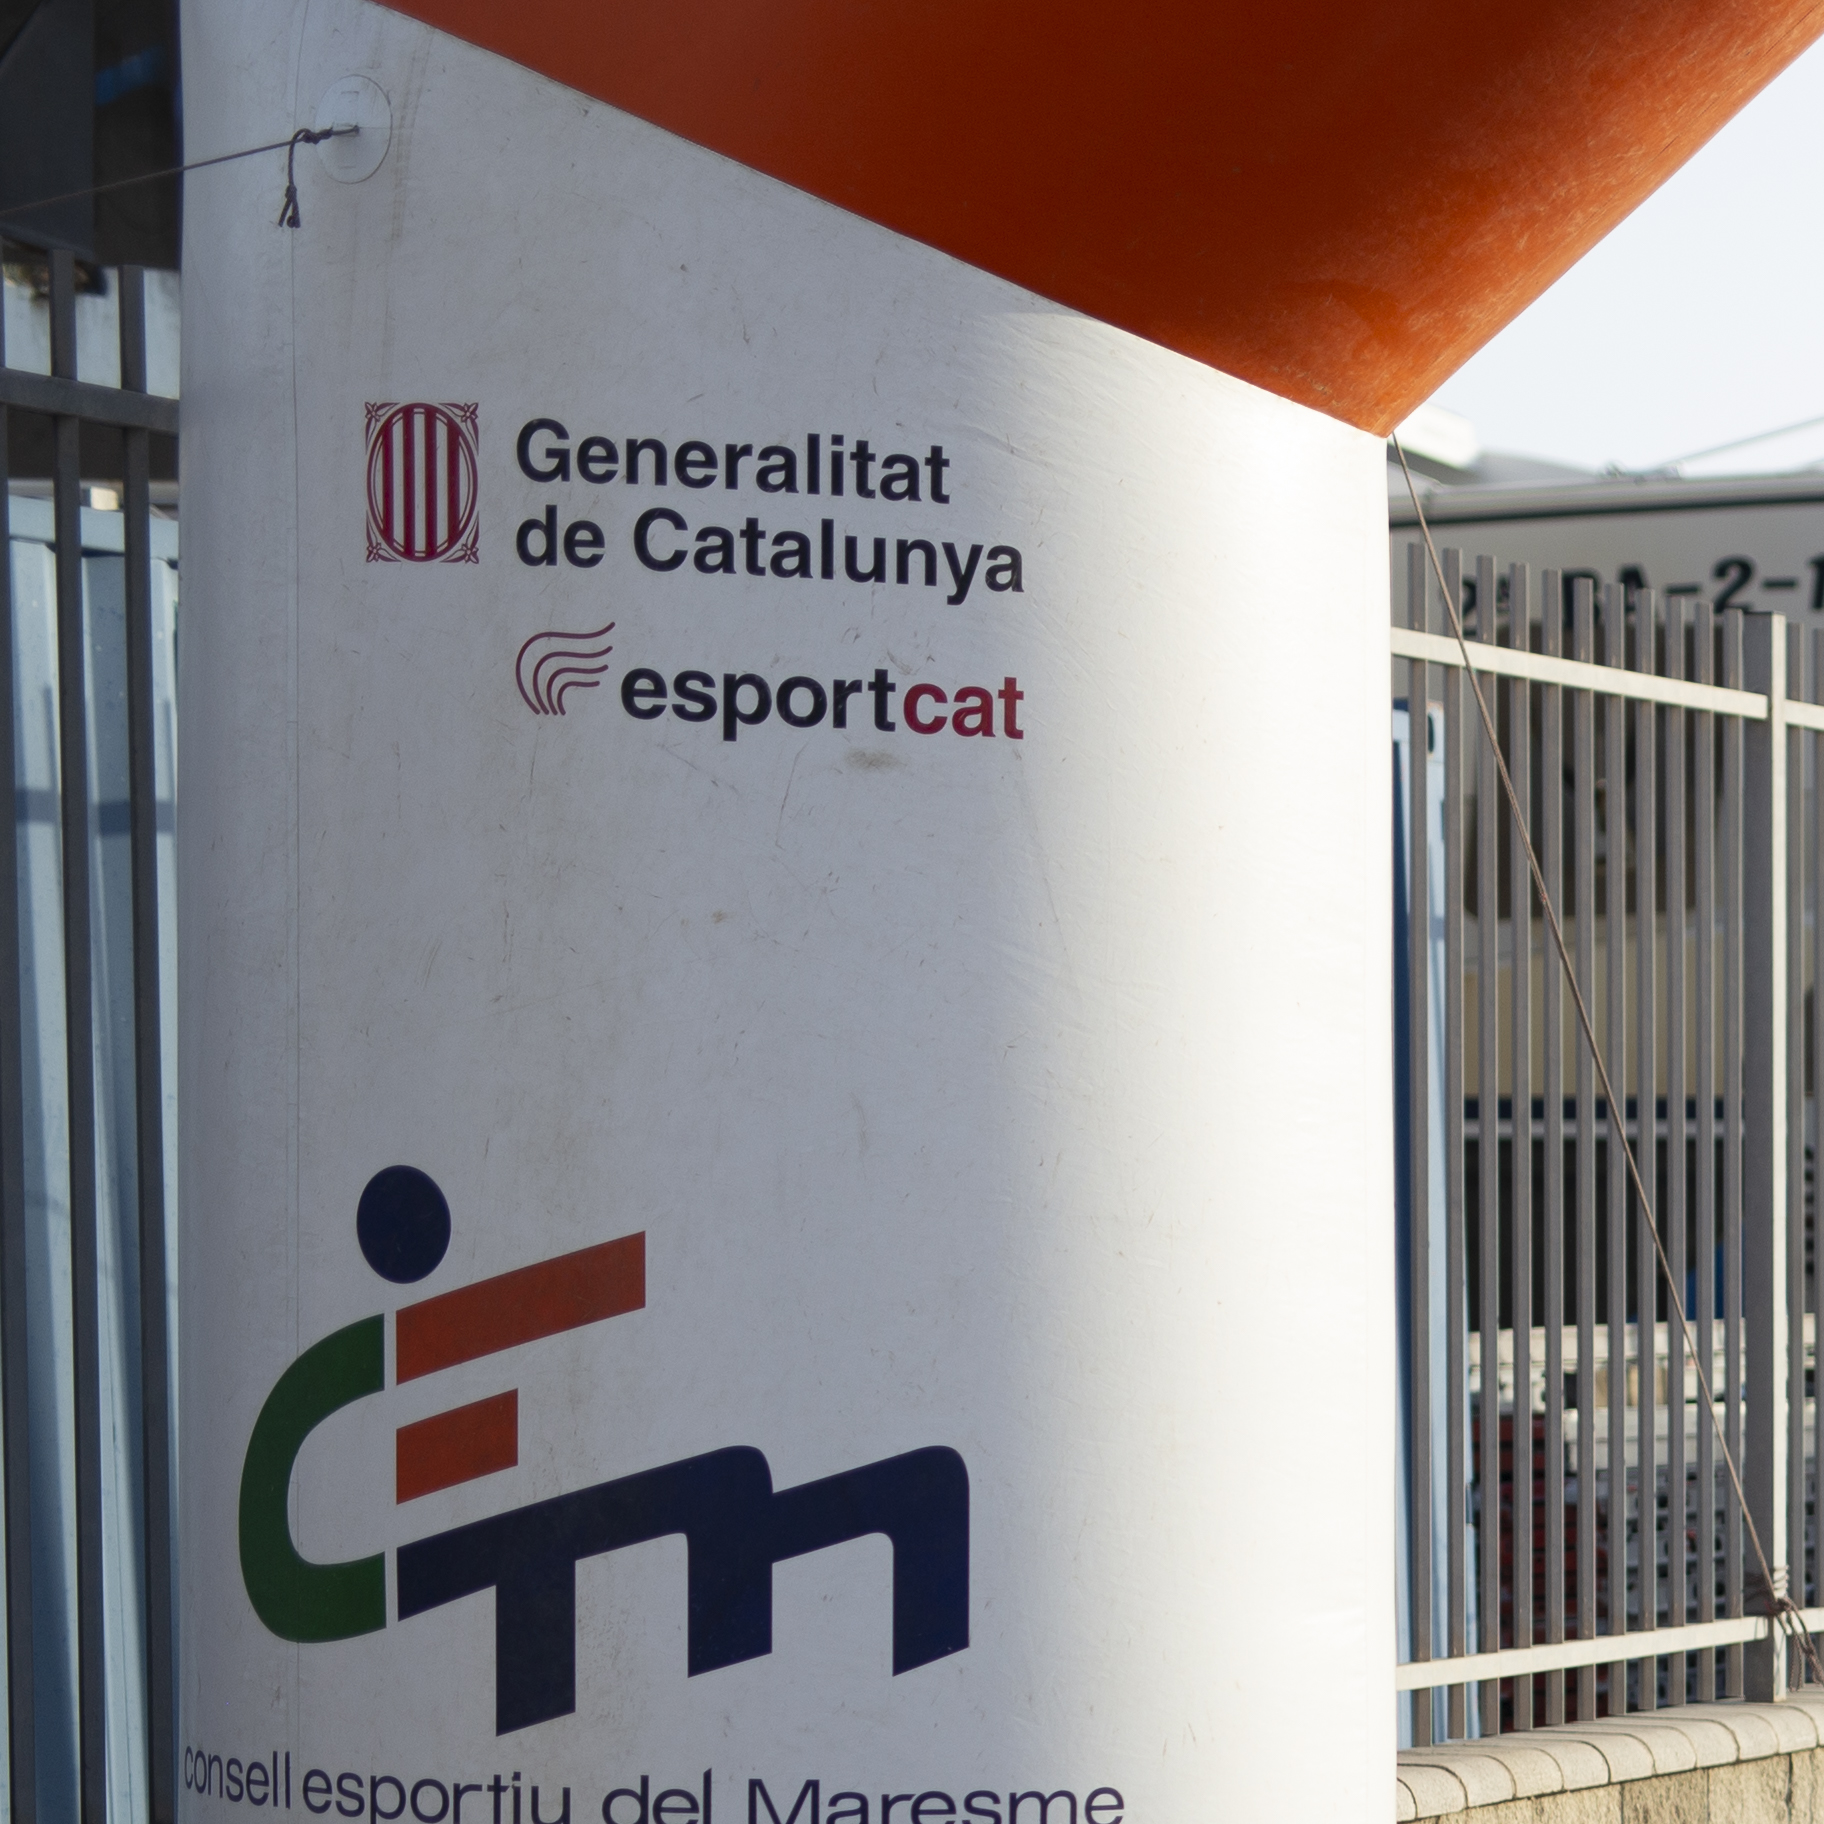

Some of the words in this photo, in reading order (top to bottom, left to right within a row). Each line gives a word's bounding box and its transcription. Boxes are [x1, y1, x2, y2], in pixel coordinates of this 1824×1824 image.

[516, 416, 951, 505] Generalitat
[516, 505, 606, 568] de
[633, 507, 1026, 606] Catalunya
[620, 662, 1026, 742] esportcat
[184, 1747, 291, 1810] consell
